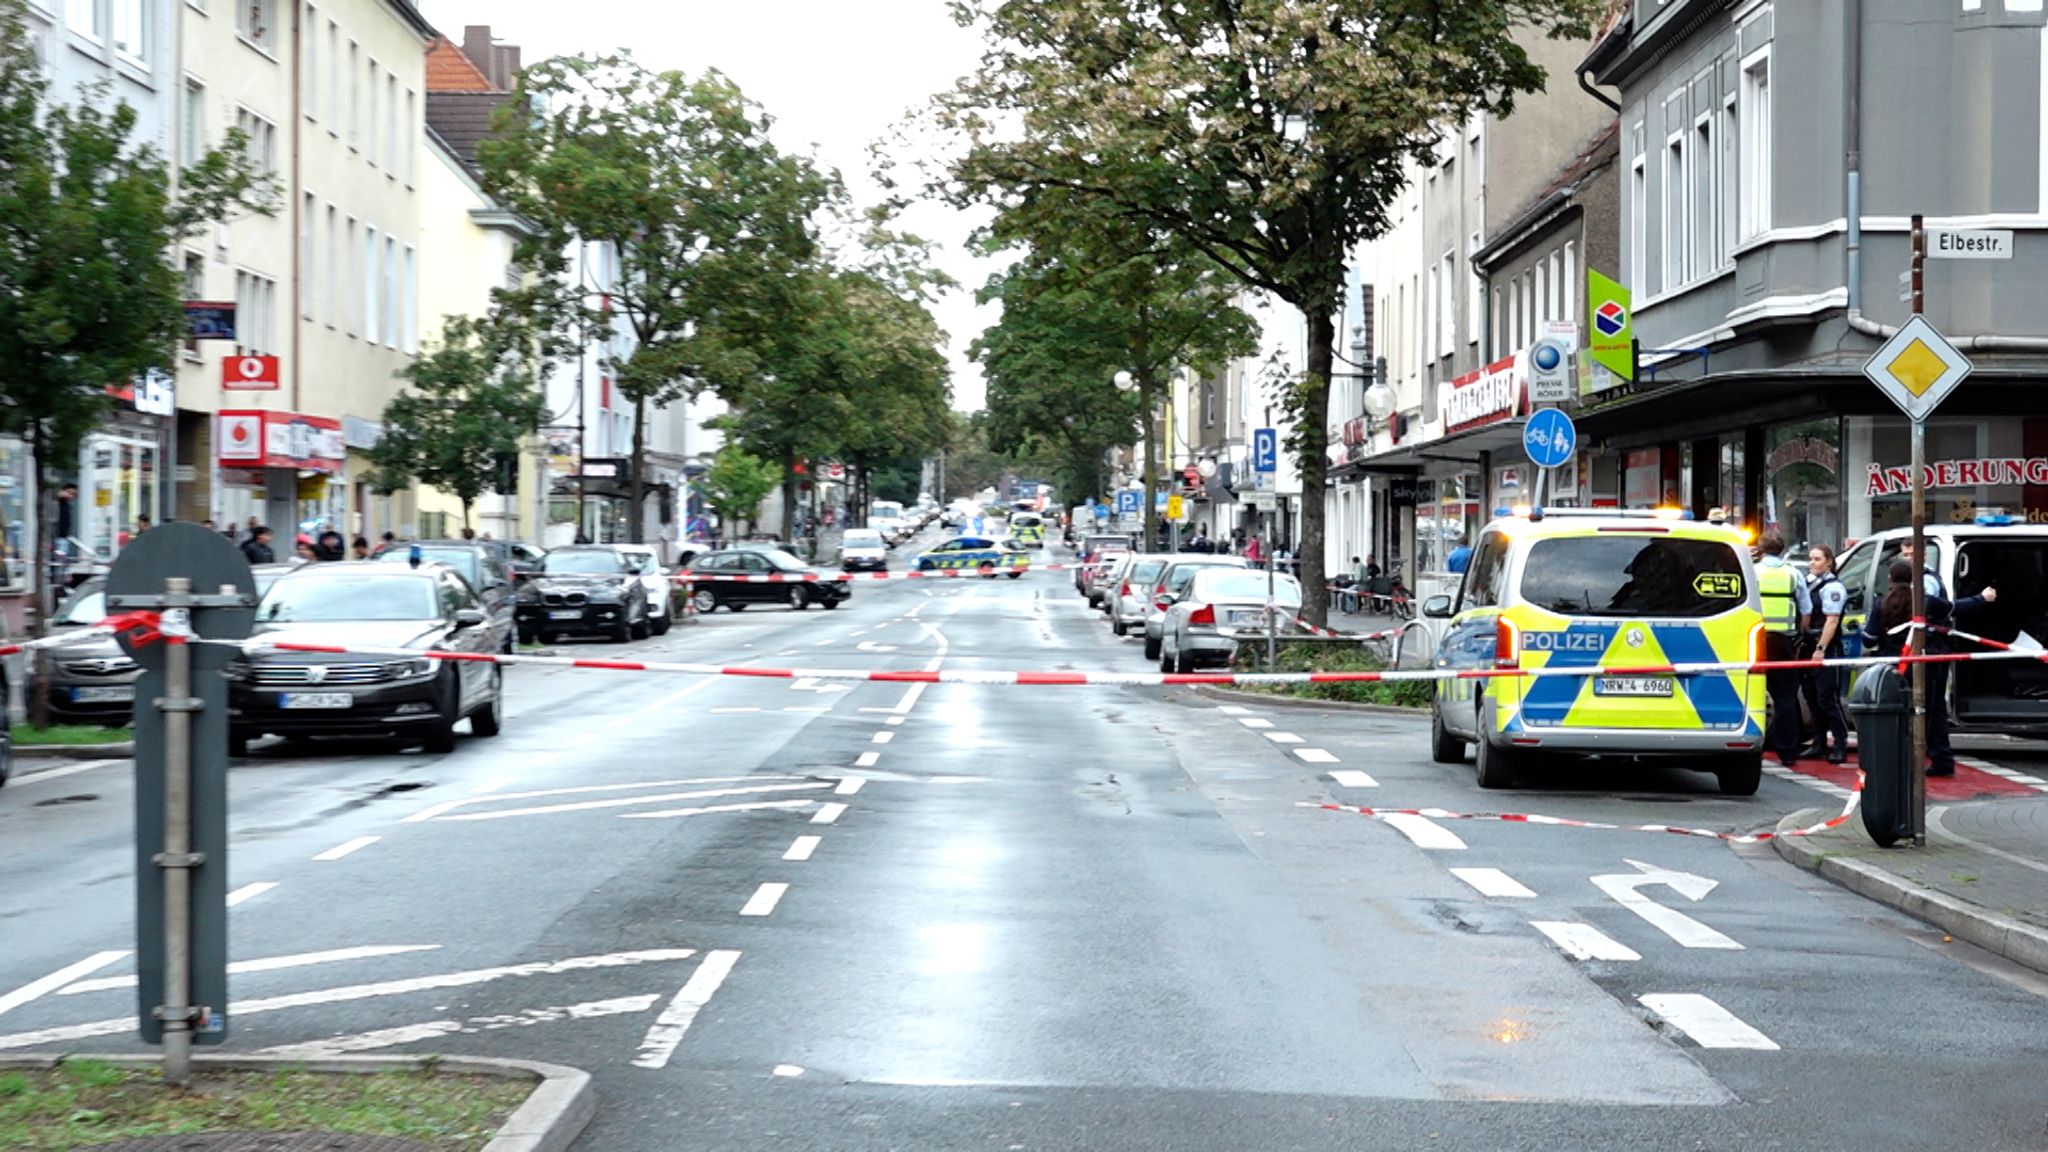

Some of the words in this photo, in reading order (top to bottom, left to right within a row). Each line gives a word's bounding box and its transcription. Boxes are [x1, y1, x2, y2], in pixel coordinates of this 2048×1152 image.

[1939, 232, 2003, 251] Elbestr.
[1258, 434, 1272, 468] P
[1522, 632, 1605, 651] POLIZEI
